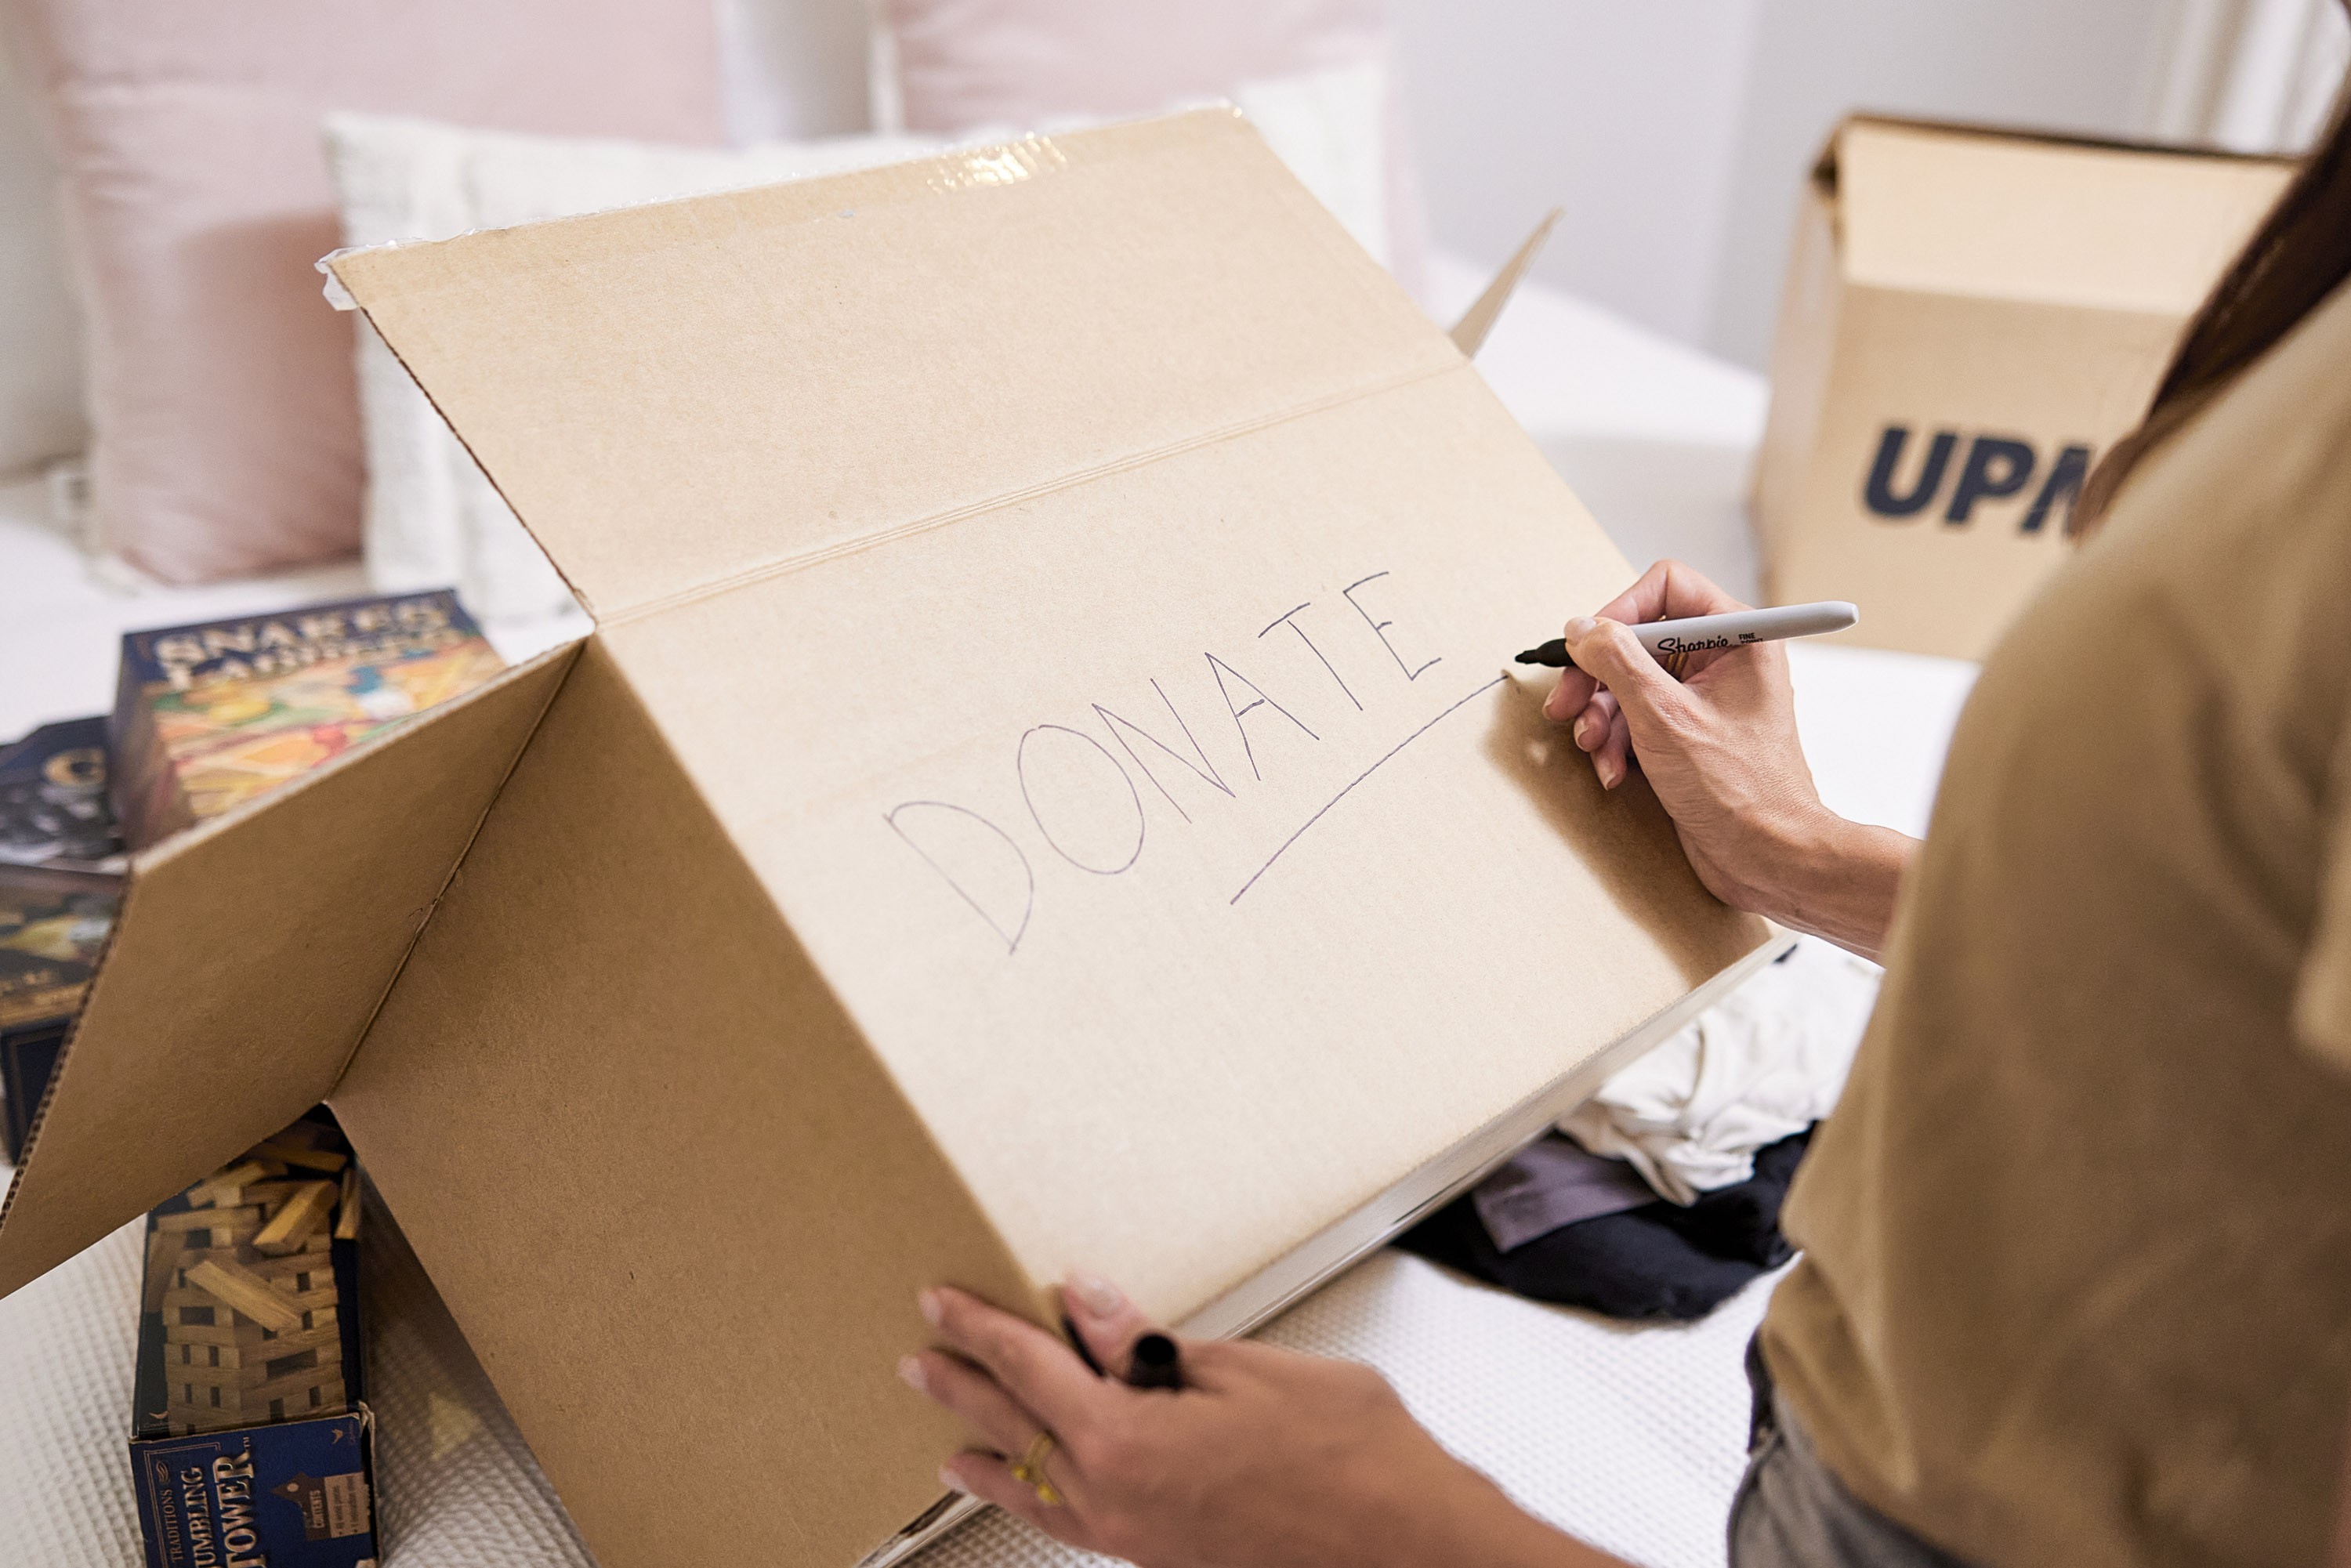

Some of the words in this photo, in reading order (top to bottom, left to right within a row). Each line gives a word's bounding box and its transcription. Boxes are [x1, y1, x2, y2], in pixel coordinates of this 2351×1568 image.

[1657, 635, 1729, 655] Sharpie
[883, 571, 1442, 954] DONATE
[160, 1489, 184, 1563] TRADITIONS
[181, 1467, 219, 1568] UMBLING
[309, 1490, 325, 1529] CONTENTS
